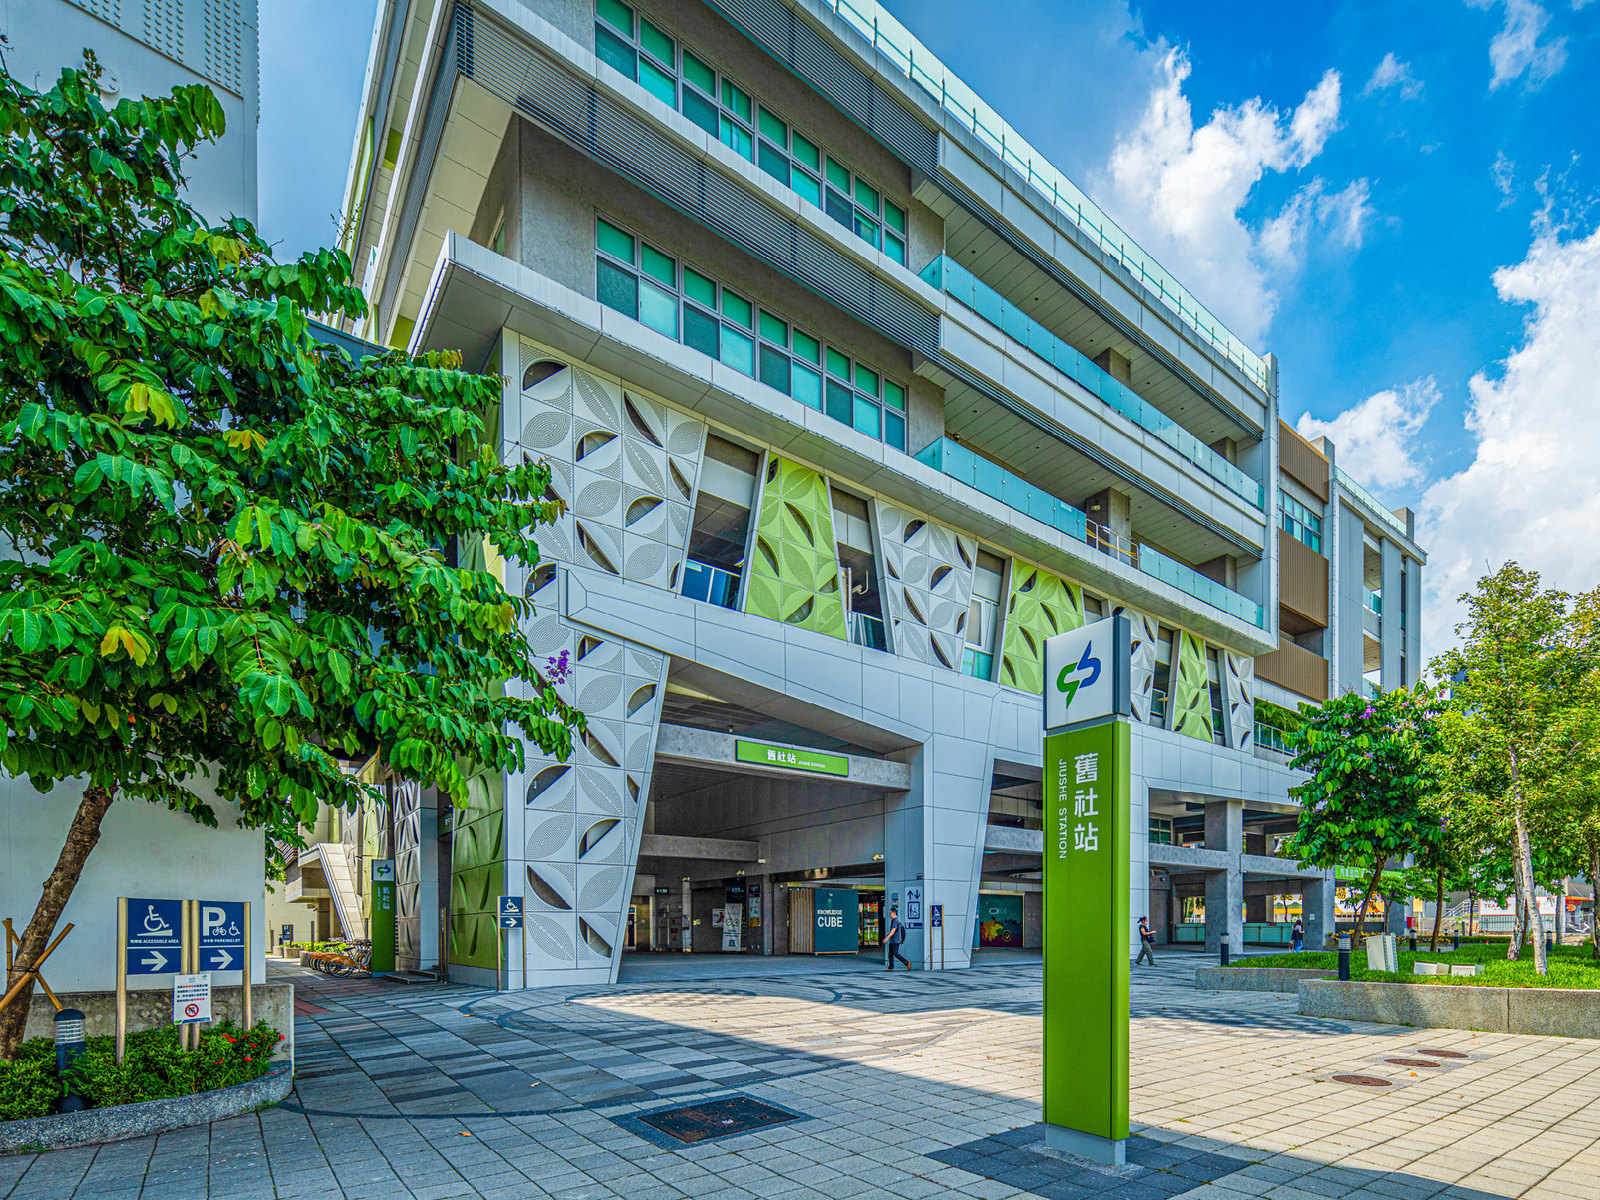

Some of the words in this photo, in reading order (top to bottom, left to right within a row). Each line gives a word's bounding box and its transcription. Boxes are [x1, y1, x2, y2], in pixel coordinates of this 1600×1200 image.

[1058, 758, 1067, 802] JIUSHE
[1074, 752, 1099, 852] 舊社站
[1058, 807, 1067, 859] STATION
[202, 906, 227, 936] P
[817, 916, 843, 928] CUBE
